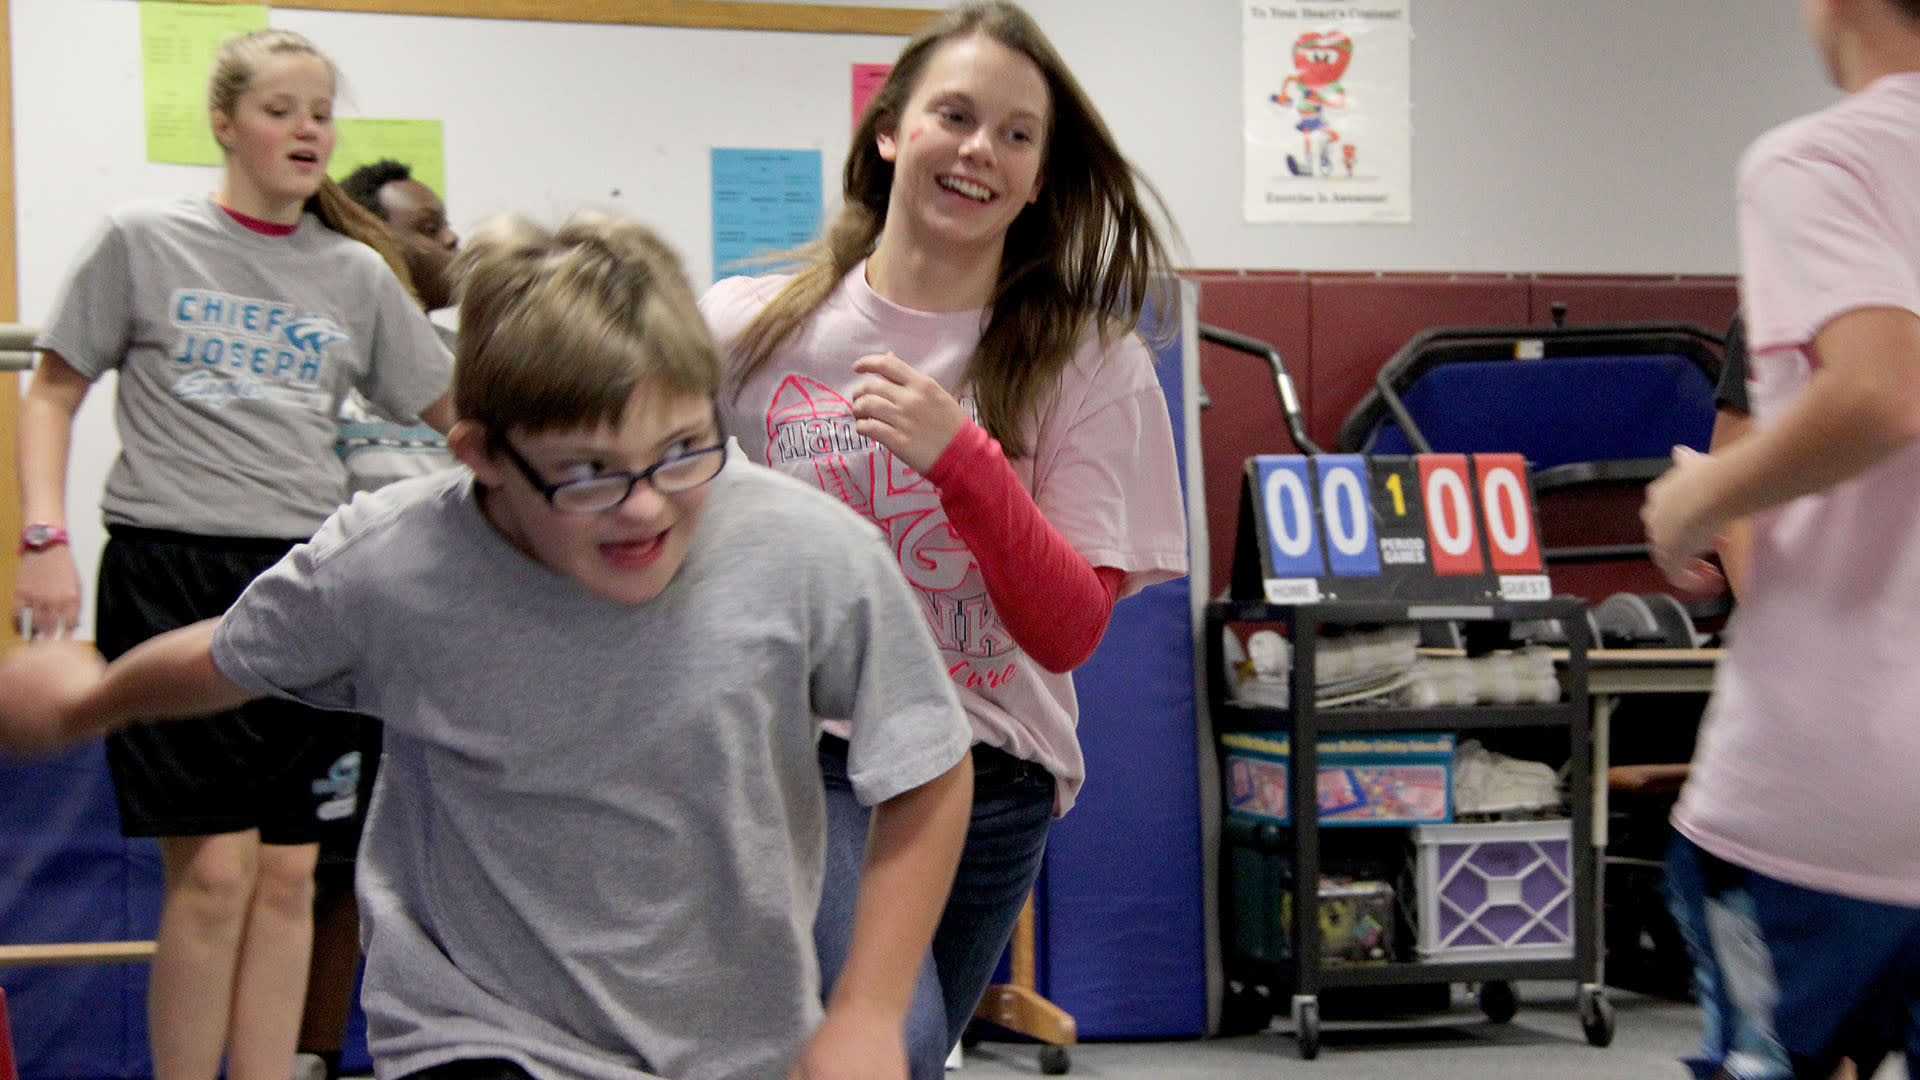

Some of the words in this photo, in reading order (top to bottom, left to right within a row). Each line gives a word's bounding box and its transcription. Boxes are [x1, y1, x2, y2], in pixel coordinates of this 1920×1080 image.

[177, 295, 286, 333] CHIEF
[176, 336, 323, 381] JOSEPH
[1385, 473, 1406, 516] 1
